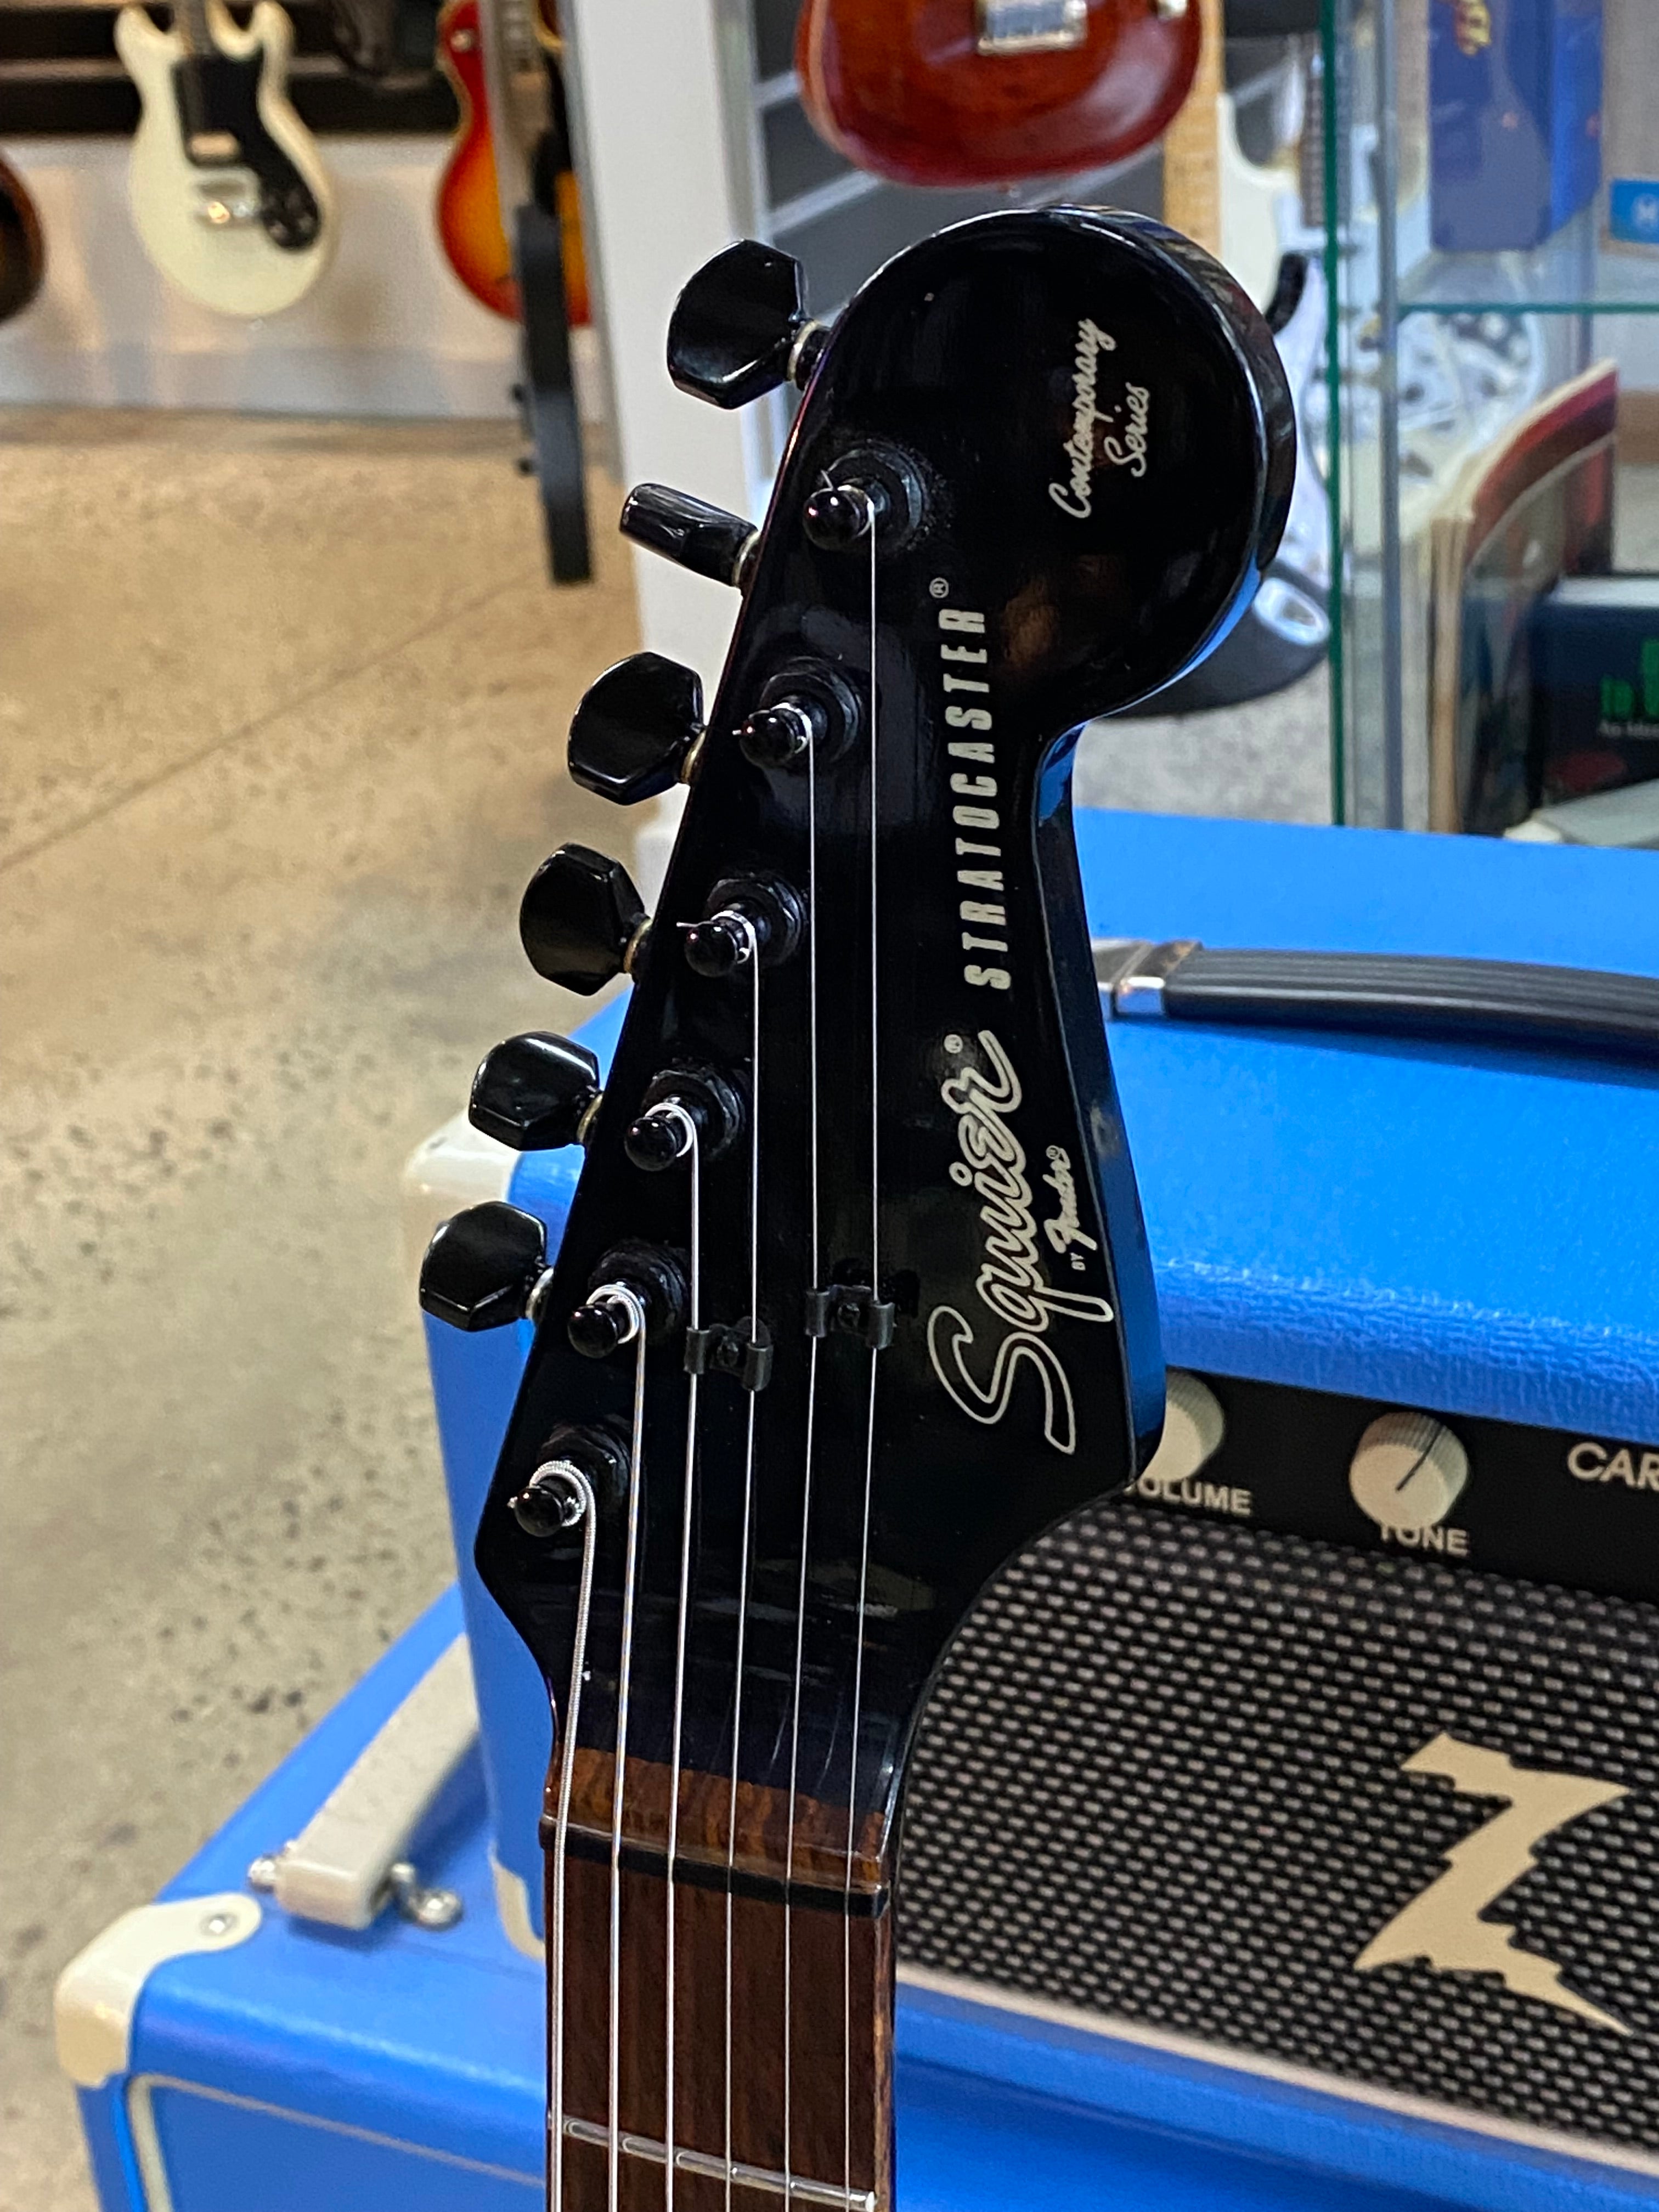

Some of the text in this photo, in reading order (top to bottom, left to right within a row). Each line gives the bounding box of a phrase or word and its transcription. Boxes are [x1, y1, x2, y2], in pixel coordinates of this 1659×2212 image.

[1049, 318, 1117, 518] Contemporary
[1104, 381, 1150, 477] Series
[1125, 1477, 1251, 1516] OLUME
